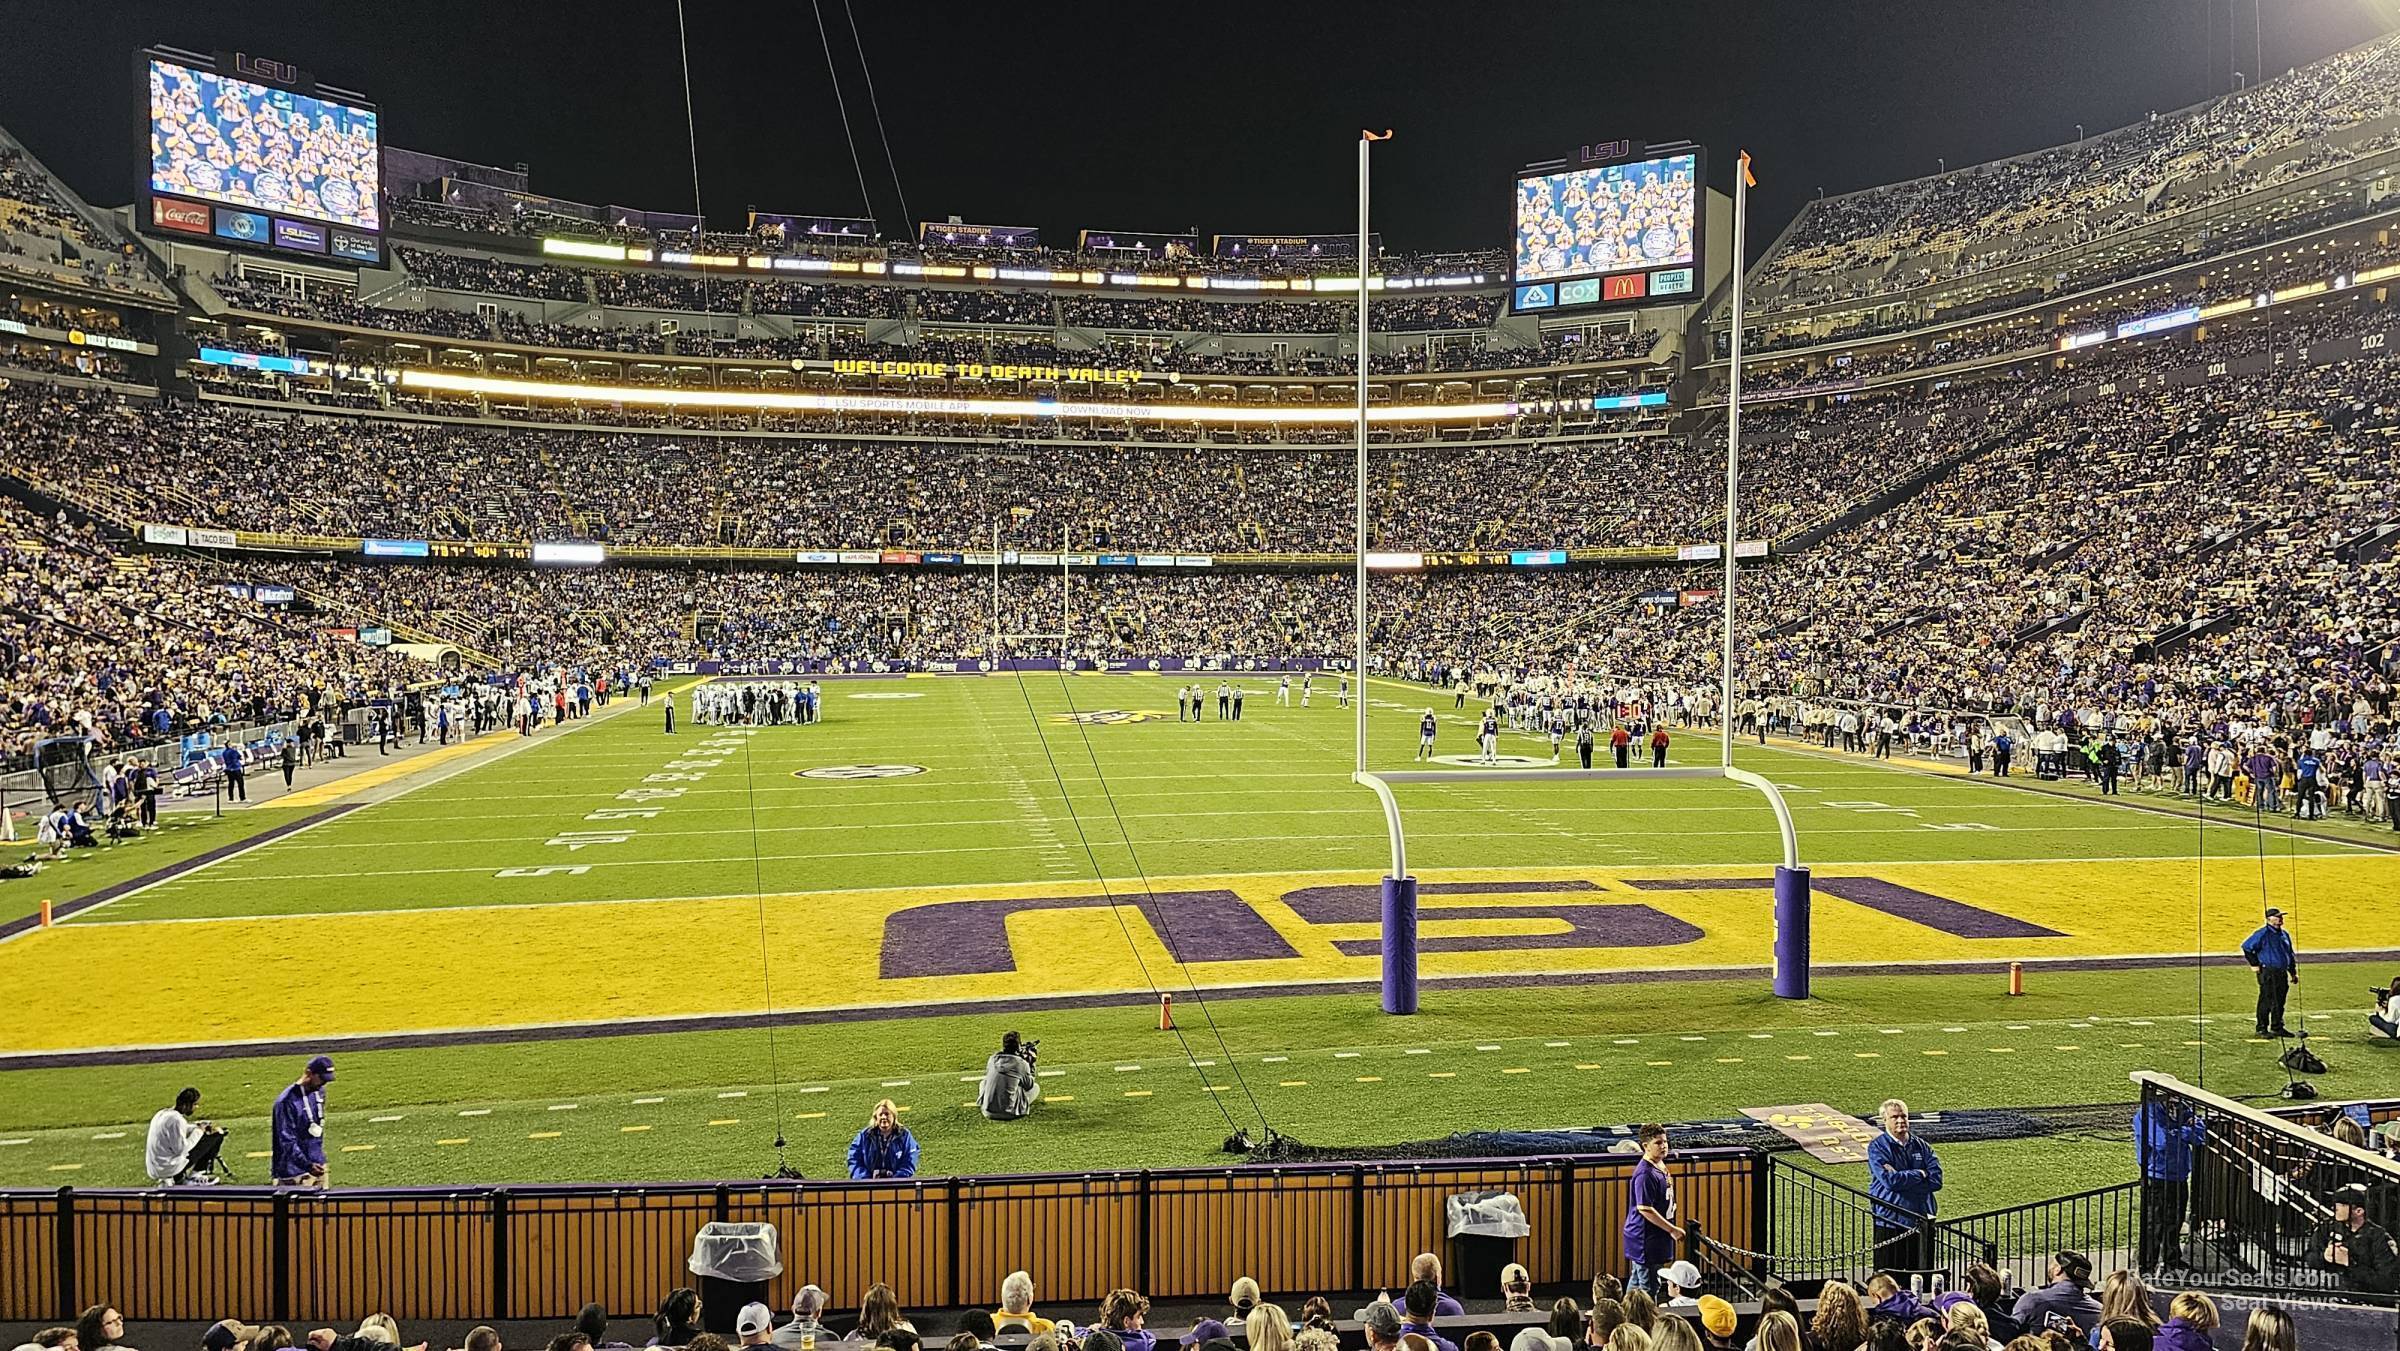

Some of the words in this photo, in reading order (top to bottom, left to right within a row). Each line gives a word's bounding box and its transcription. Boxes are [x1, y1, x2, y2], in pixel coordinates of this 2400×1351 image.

[236, 52, 296, 84] LSU
[1581, 140, 1629, 162] LSU
[280, 226, 301, 237] LSU
[935, 225, 957, 233] TIGER
[958, 226, 992, 235] STADIUM
[1561, 284, 1598, 300] COX
[2360, 334, 2384, 350] 102
[833, 359, 947, 376] WELCOME
[956, 364, 983, 378] TO
[991, 365, 1059, 380] DEATH
[1067, 368, 1142, 383] VALLEY
[2207, 363, 2227, 377] 101
[2098, 383, 2116, 396] 100
[860, 400, 903, 409] SPORTS
[949, 402, 970, 411] APP
[1063, 405, 1124, 415] DOWNLOAD
[1126, 407, 1151, 416] NOW
[1794, 429, 1811, 440] 422
[201, 534, 218, 544] TACO
[219, 535, 234, 545] BELL
[265, 588, 294, 601] Marathon
[1323, 659, 1352, 670] LSU
[494, 864, 592, 878] 5
[879, 876, 2070, 980] LSU
[1817, 1136, 1862, 1160] LSU
